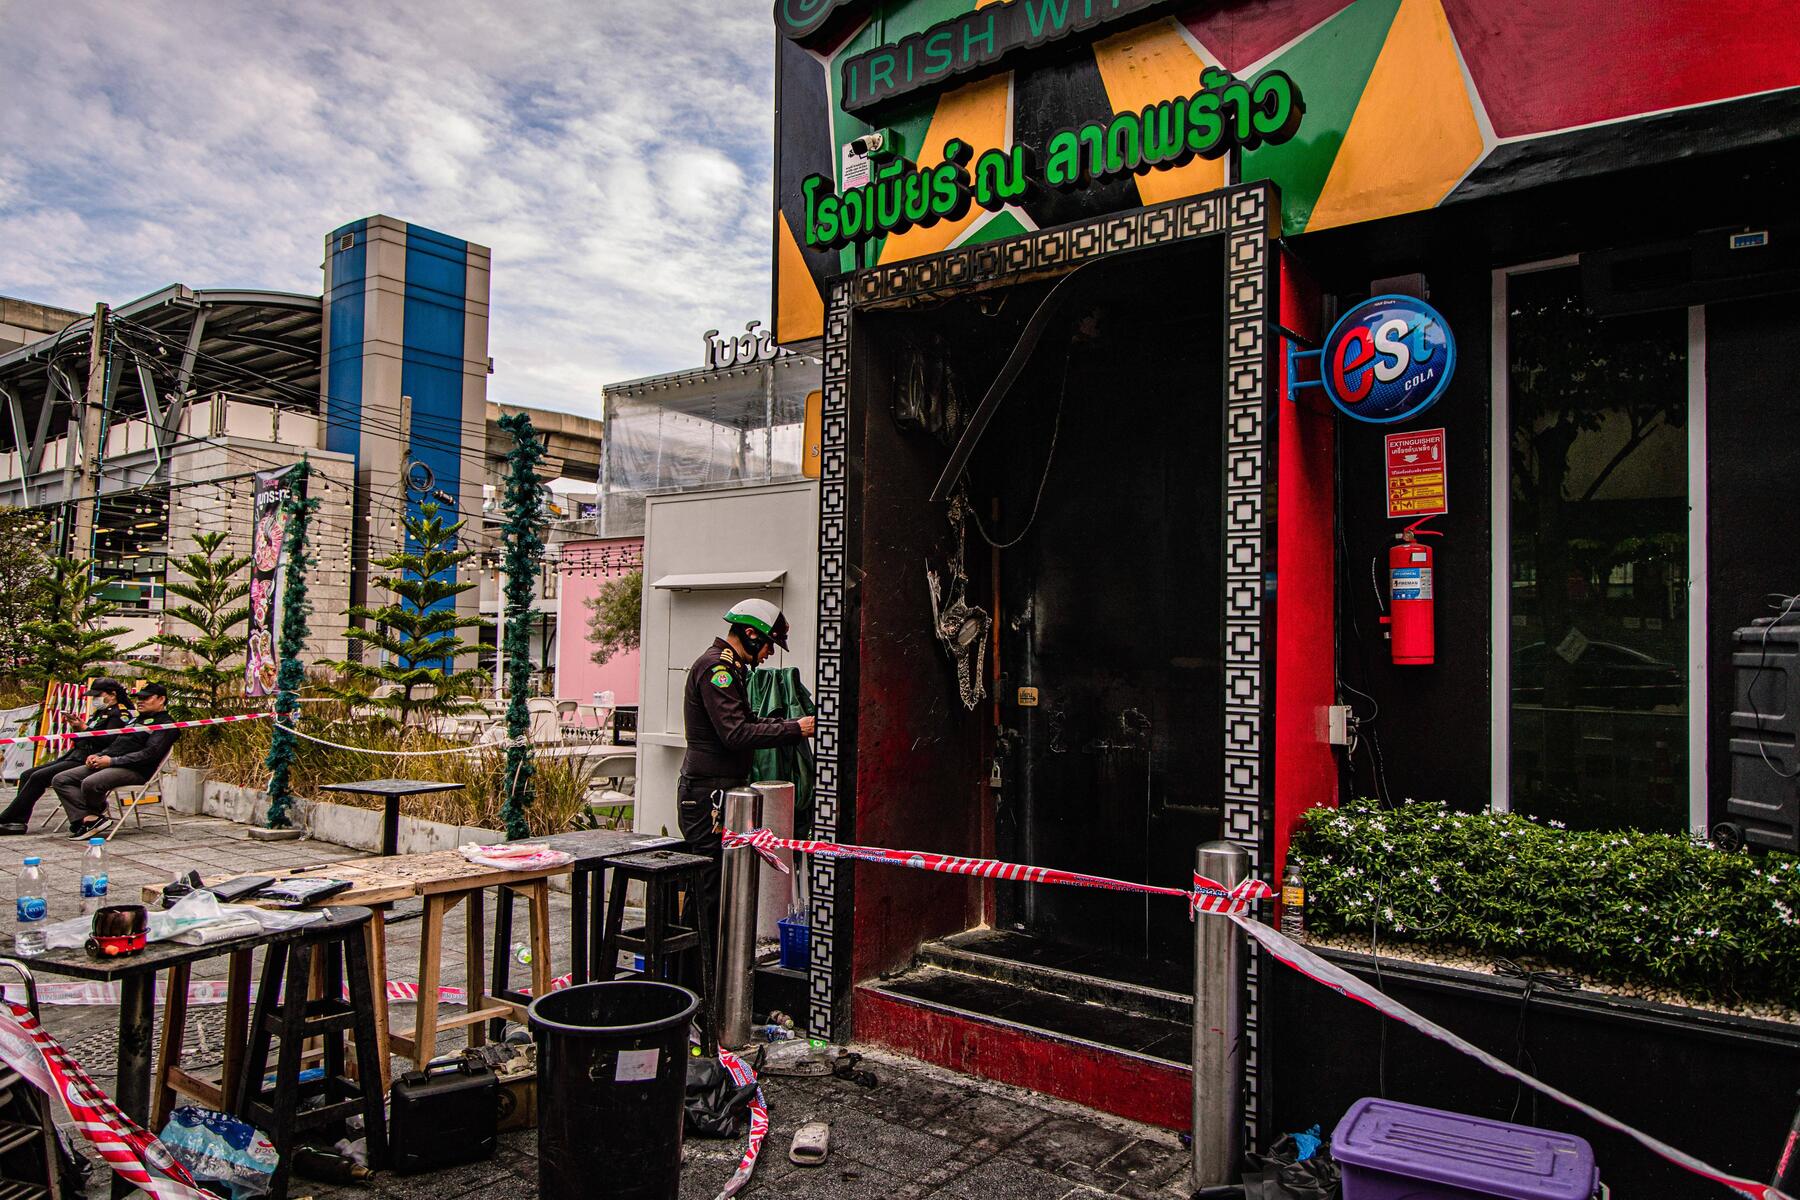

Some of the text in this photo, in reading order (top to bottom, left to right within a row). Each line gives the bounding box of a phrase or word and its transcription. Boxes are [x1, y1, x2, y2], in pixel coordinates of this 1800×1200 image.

[850, 15, 995, 101] IRISH
[802, 71, 1292, 246] โรงเบียร์ ณ ลาดพร้าว
[1404, 367, 1434, 391] COLA
[1389, 436, 1441, 448] EXTINGUISHER
